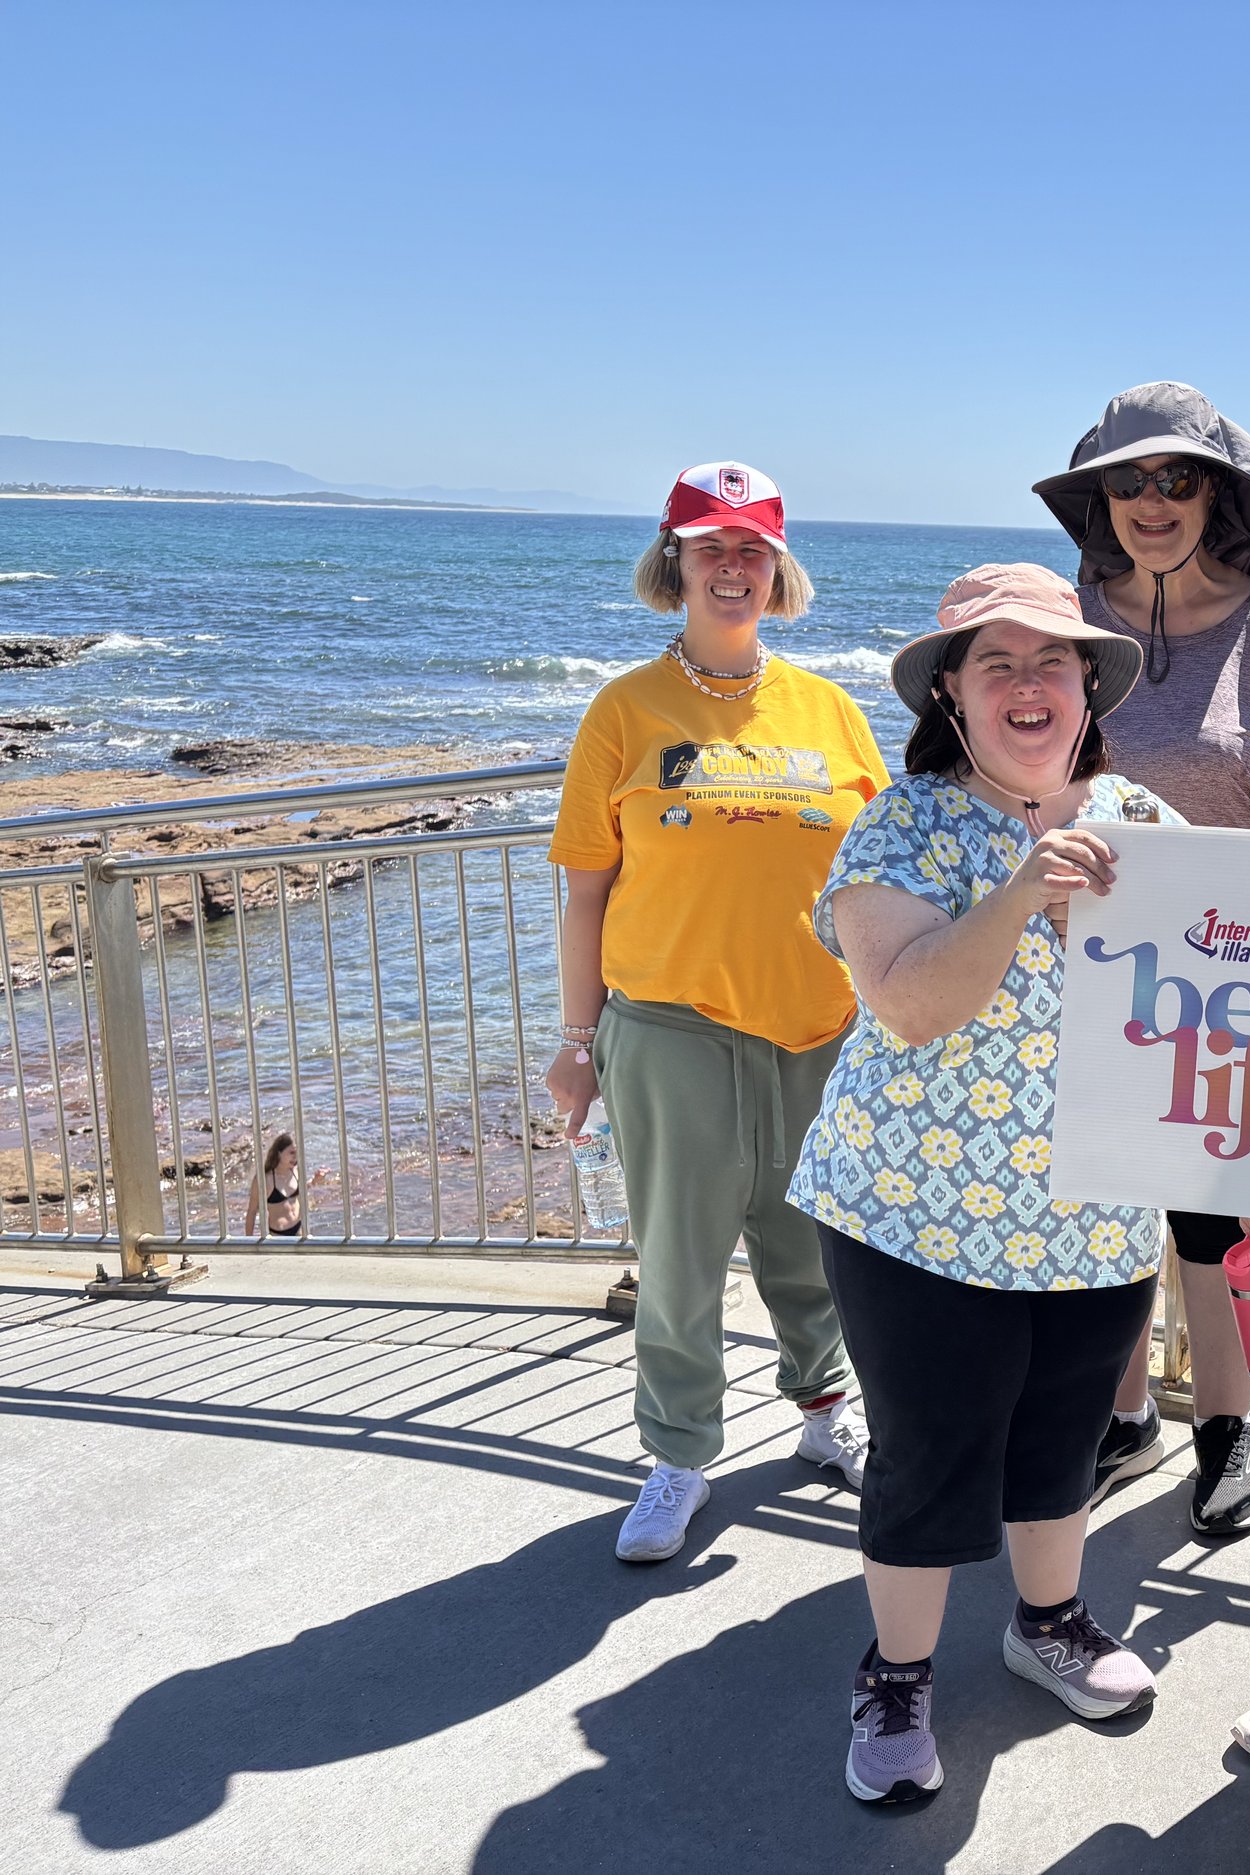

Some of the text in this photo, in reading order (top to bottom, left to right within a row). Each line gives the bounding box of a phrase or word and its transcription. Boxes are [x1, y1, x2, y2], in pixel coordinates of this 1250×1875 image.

[702, 756, 788, 776] CONVOY
[686, 791, 811, 804] PLATINUM EVENT SPONSORS
[666, 809, 687, 820] WIN
